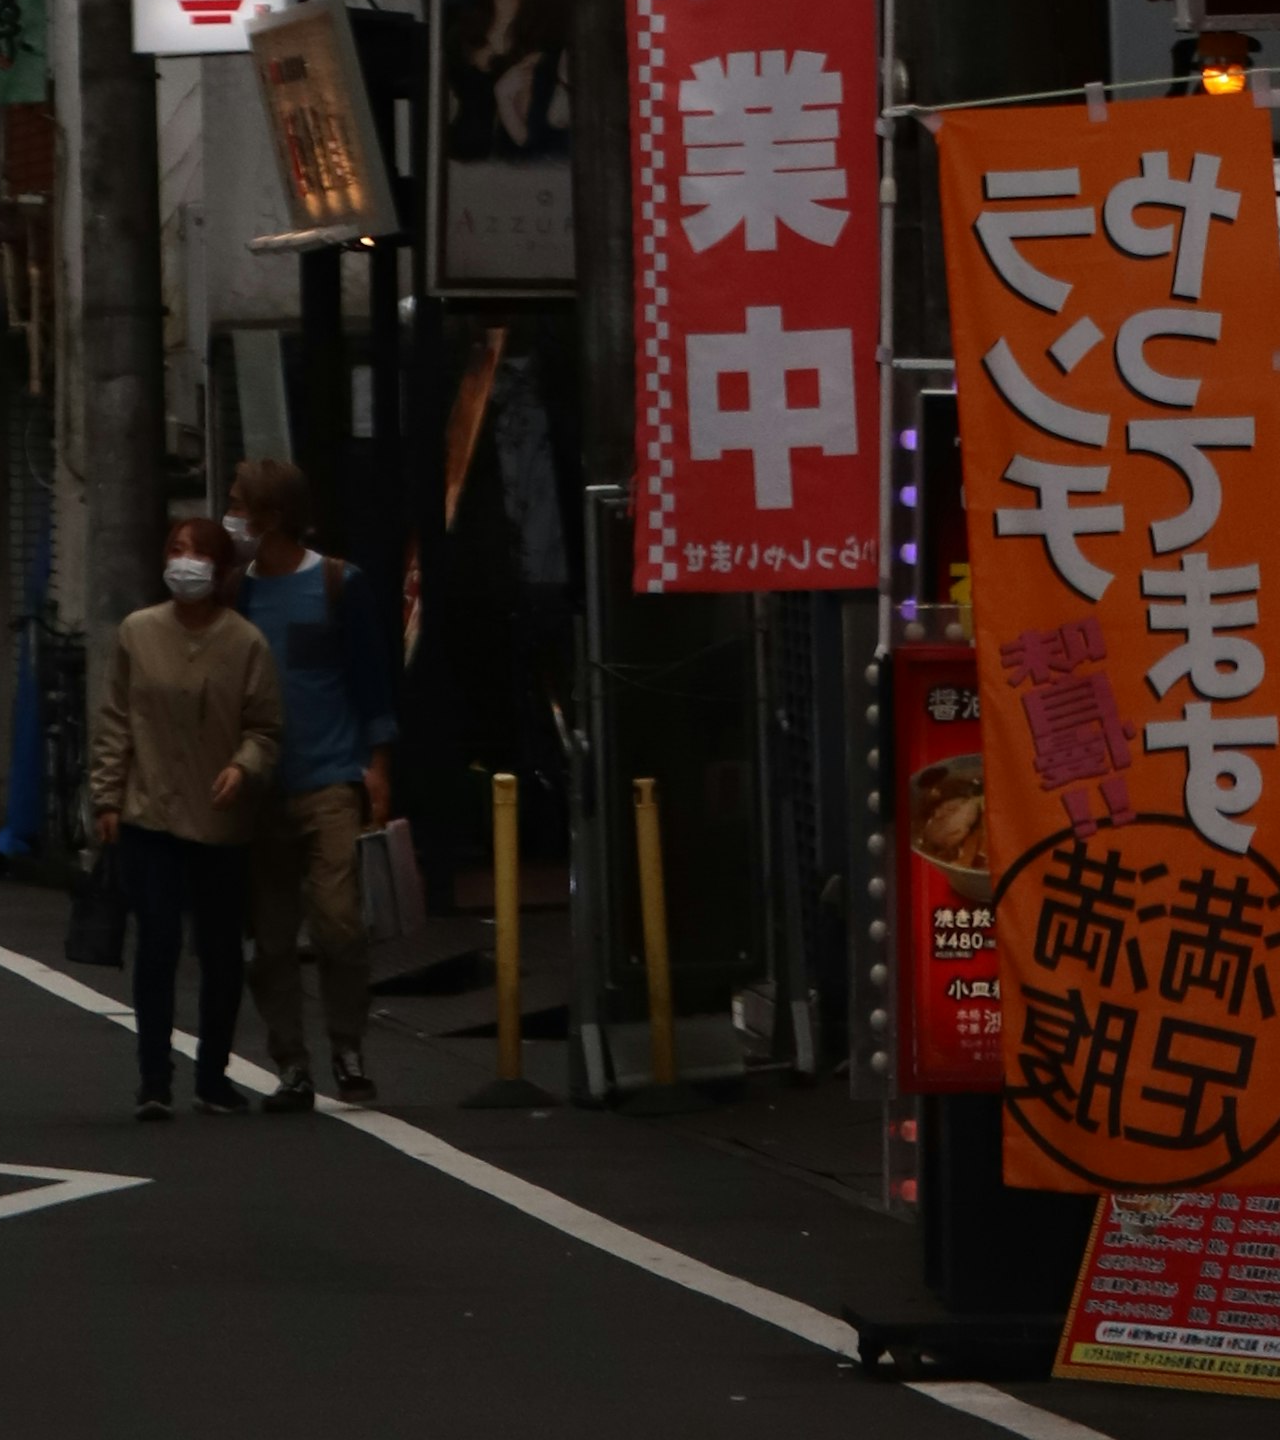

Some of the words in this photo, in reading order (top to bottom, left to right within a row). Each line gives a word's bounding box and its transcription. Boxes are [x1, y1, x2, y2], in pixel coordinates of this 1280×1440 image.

[933, 907, 996, 929] 焼き餃
[934, 931, 984, 950] ¥480
